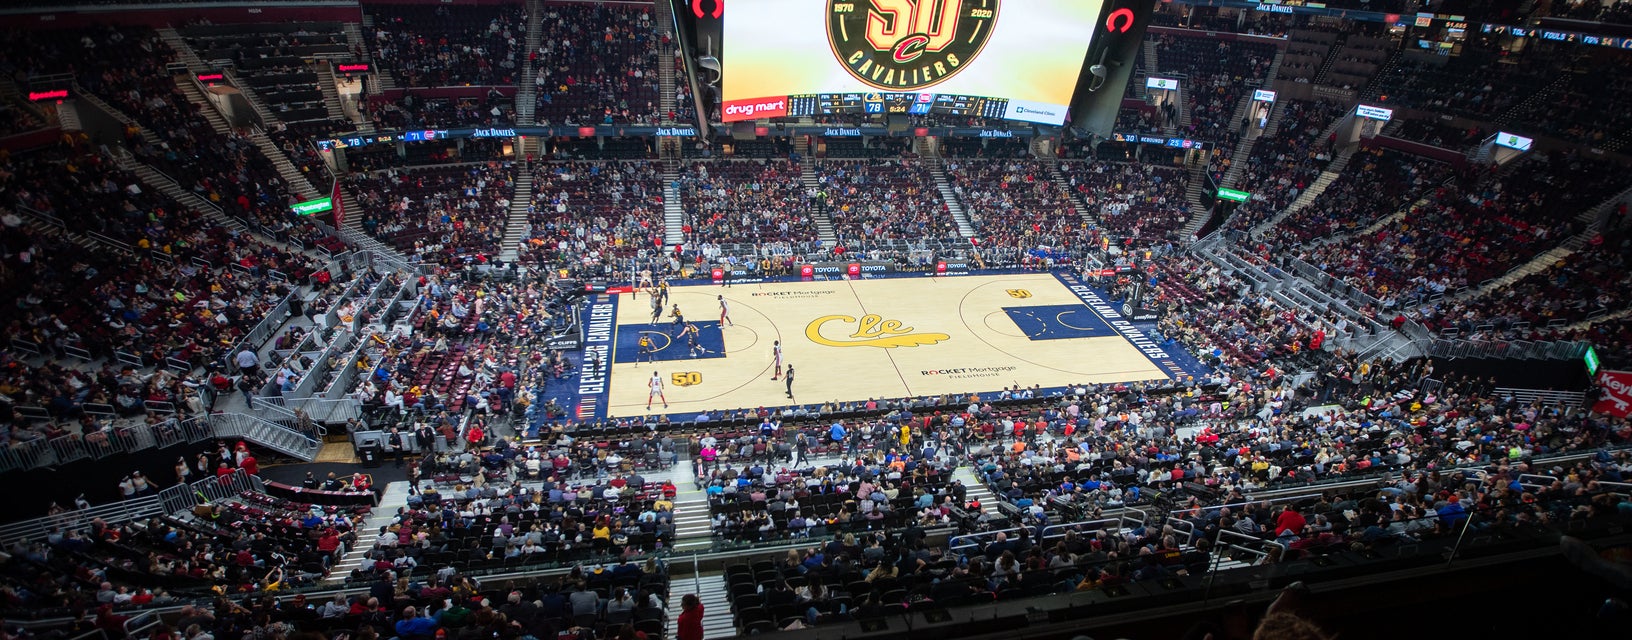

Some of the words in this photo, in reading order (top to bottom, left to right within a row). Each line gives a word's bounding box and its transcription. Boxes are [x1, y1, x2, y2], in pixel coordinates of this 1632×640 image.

[834, 4, 854, 12] 1970
[1255, 3, 1271, 12] JACK
[1271, 4, 1293, 14] DANIEL'S
[971, 9, 992, 18] 2020
[865, 0, 963, 52] 50
[1528, 29, 1536, 37] 4
[1543, 32, 1566, 41] FOULS
[1567, 33, 1576, 42] 2
[1601, 37, 1613, 46] 54
[849, 50, 960, 86] CAVALIERS
[725, 103, 752, 115] drug
[755, 101, 784, 112] mart
[868, 103, 881, 112] 78
[916, 103, 926, 112] 71
[1024, 108, 1044, 116] Cleveland
[410, 132, 420, 140] 71
[473, 128, 490, 137] JACK
[490, 128, 516, 137] DANIEL'S
[656, 127, 671, 136] JACK
[671, 127, 695, 136] DANIEL'S
[824, 128, 838, 136] JACK
[839, 128, 861, 136] DANIEL'S
[979, 129, 992, 137] JACK
[992, 129, 1012, 137] DANIEL'S
[348, 138, 360, 147] 78
[299, 202, 330, 211] Huntington
[1005, 289, 1032, 299] 50
[587, 303, 614, 342] CAVALIERS
[1070, 285, 1122, 318] CLEVELAND
[1111, 320, 1170, 359] CAVALIERS
[805, 314, 951, 348] Cle
[579, 345, 609, 395] CLEVELAND
[921, 367, 967, 376] ROCKET
[968, 365, 1017, 373] Mortgage
[671, 371, 703, 387] 50
